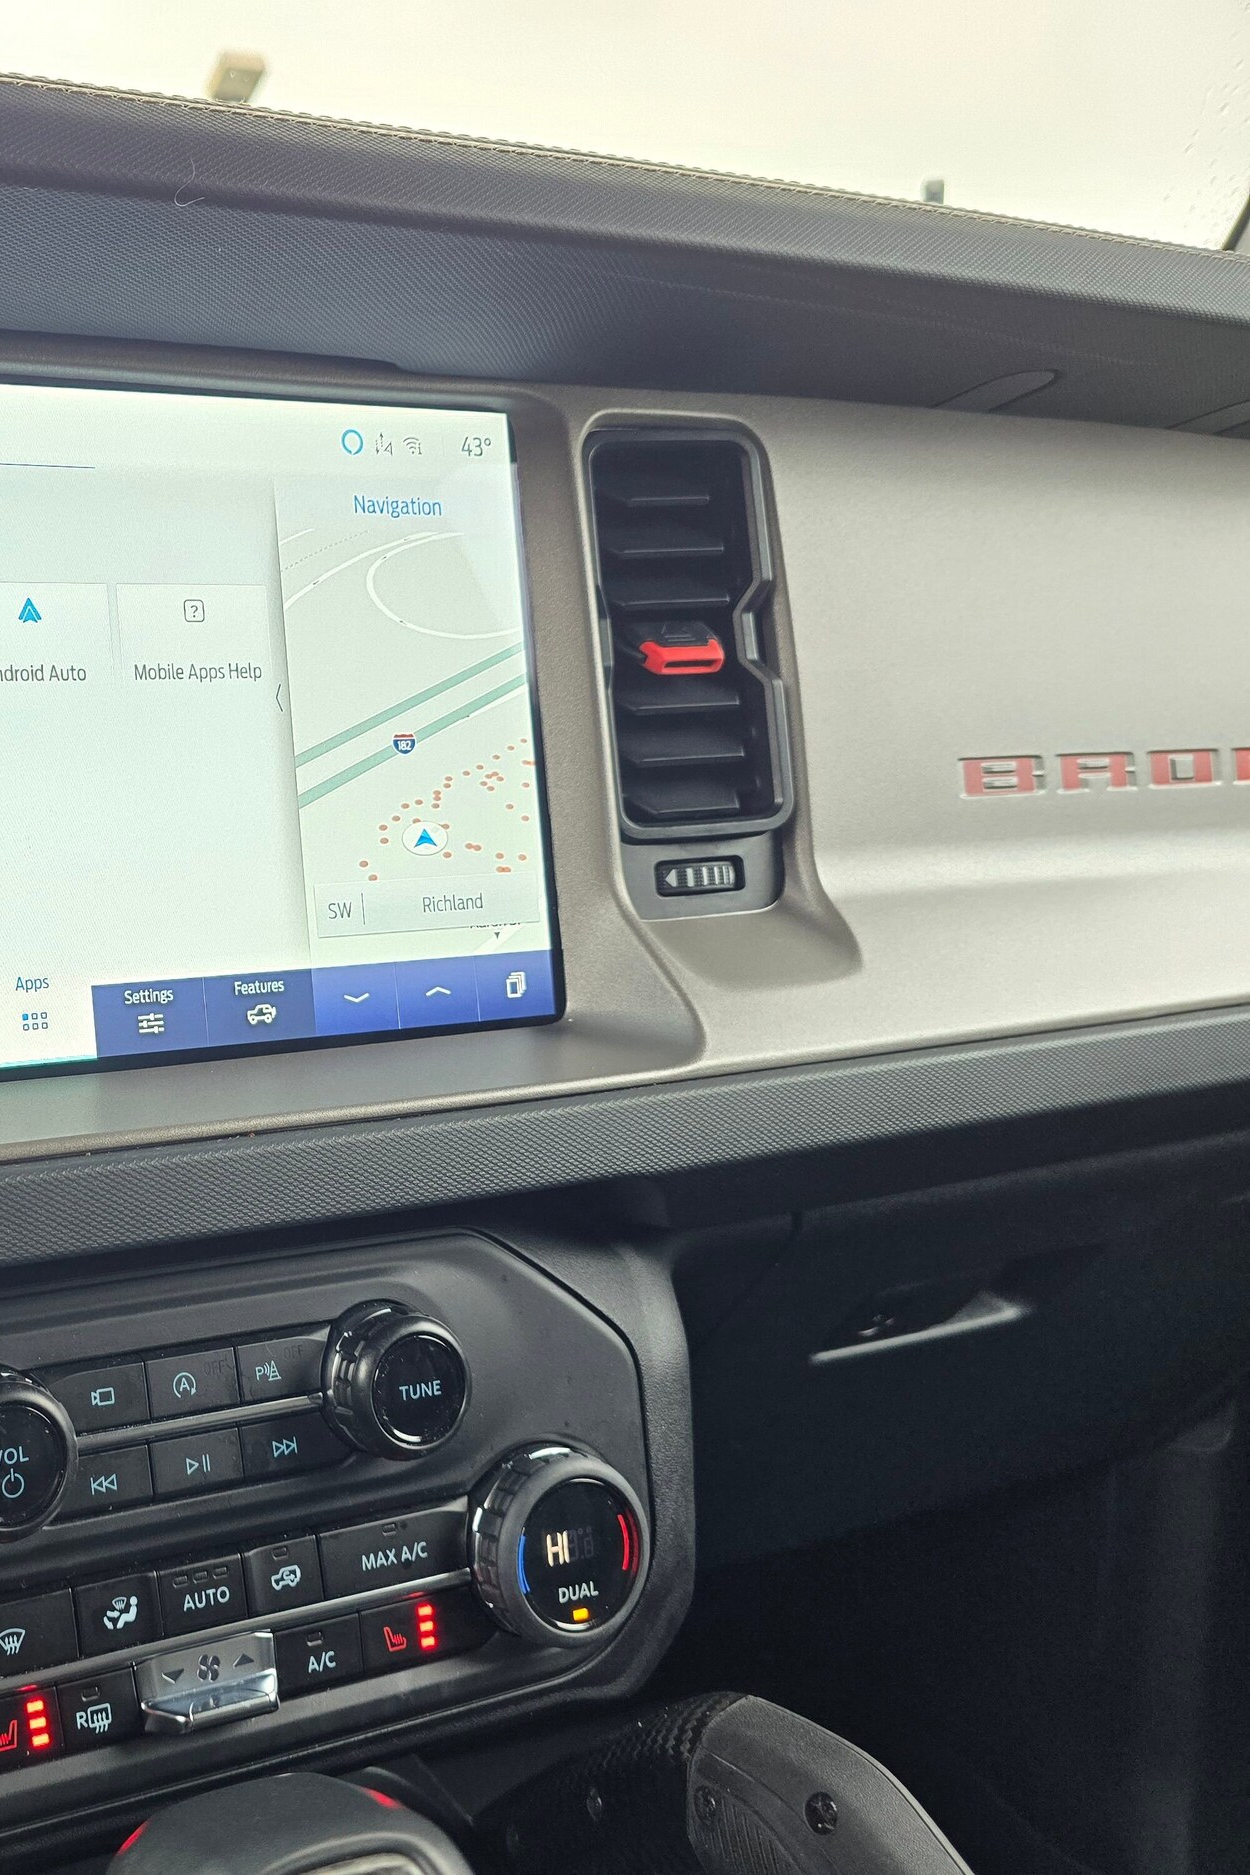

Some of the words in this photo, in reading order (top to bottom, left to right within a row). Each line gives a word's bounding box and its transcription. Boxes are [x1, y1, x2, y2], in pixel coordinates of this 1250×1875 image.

[461, 436, 492, 457] 43°
[353, 494, 443, 519] Navigation
[48, 664, 87, 682] Auto
[133, 664, 185, 682] Mobile
[188, 664, 226, 683] Apps
[228, 663, 263, 683] Help
[396, 740, 412, 751] 182
[957, 747, 1250, 799] BRO
[328, 901, 353, 920] SW
[423, 892, 484, 914] Richland
[15, 975, 50, 993] Apps
[233, 979, 285, 996] Features
[123, 987, 174, 1006] Settings
[283, 1344, 304, 1360] OFF
[203, 1358, 224, 1376] OFF
[399, 1380, 442, 1401] TUNE
[361, 1549, 398, 1571] MAX
[400, 1541, 428, 1564] A/C
[546, 1530, 571, 1567] HI
[183, 1585, 231, 1612] AUTO
[558, 1581, 599, 1603] DUAL
[307, 1650, 336, 1674] A/C
[76, 1711, 88, 1730] R
